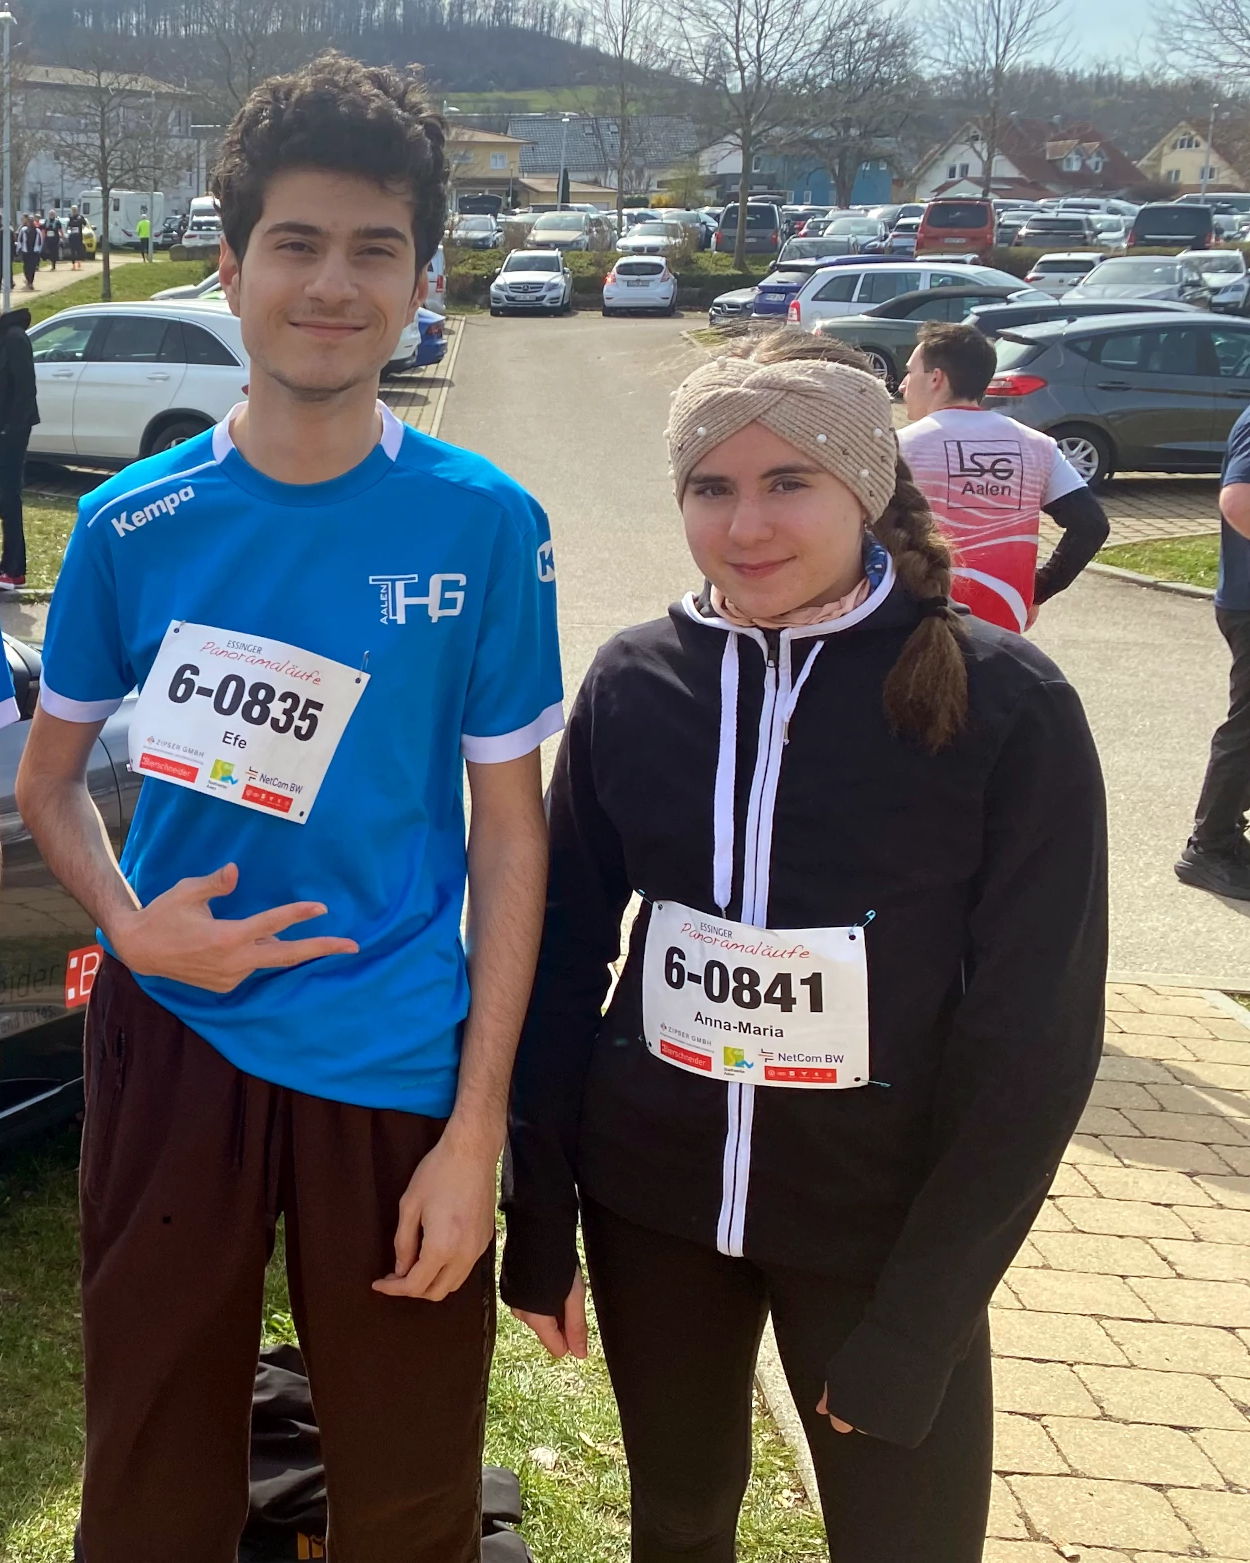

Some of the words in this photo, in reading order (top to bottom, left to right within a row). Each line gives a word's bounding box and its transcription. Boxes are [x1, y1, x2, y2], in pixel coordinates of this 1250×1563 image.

[961, 481, 1012, 496] Aalen
[111, 485, 195, 538] Kempa
[369, 573, 467, 625] THG
[379, 584, 388, 625] AALEN
[226, 639, 263, 655] ESSINGER
[200, 641, 323, 686] Panoramaläufe
[168, 663, 324, 742] 6-0835
[156, 739, 180, 750] ZIPSER
[182, 746, 205, 758] GMBH
[221, 731, 248, 750] Efe
[259, 773, 289, 790] NetCom
[289, 782, 305, 794] BW
[680, 923, 811, 959] Panoramaläufe
[700, 922, 732, 939] ESSINGER
[664, 946, 823, 1013] 6-0841
[694, 1011, 784, 1038] Anna-Maria
[778, 1052, 822, 1063] NetCom
[825, 1054, 844, 1063] BW
